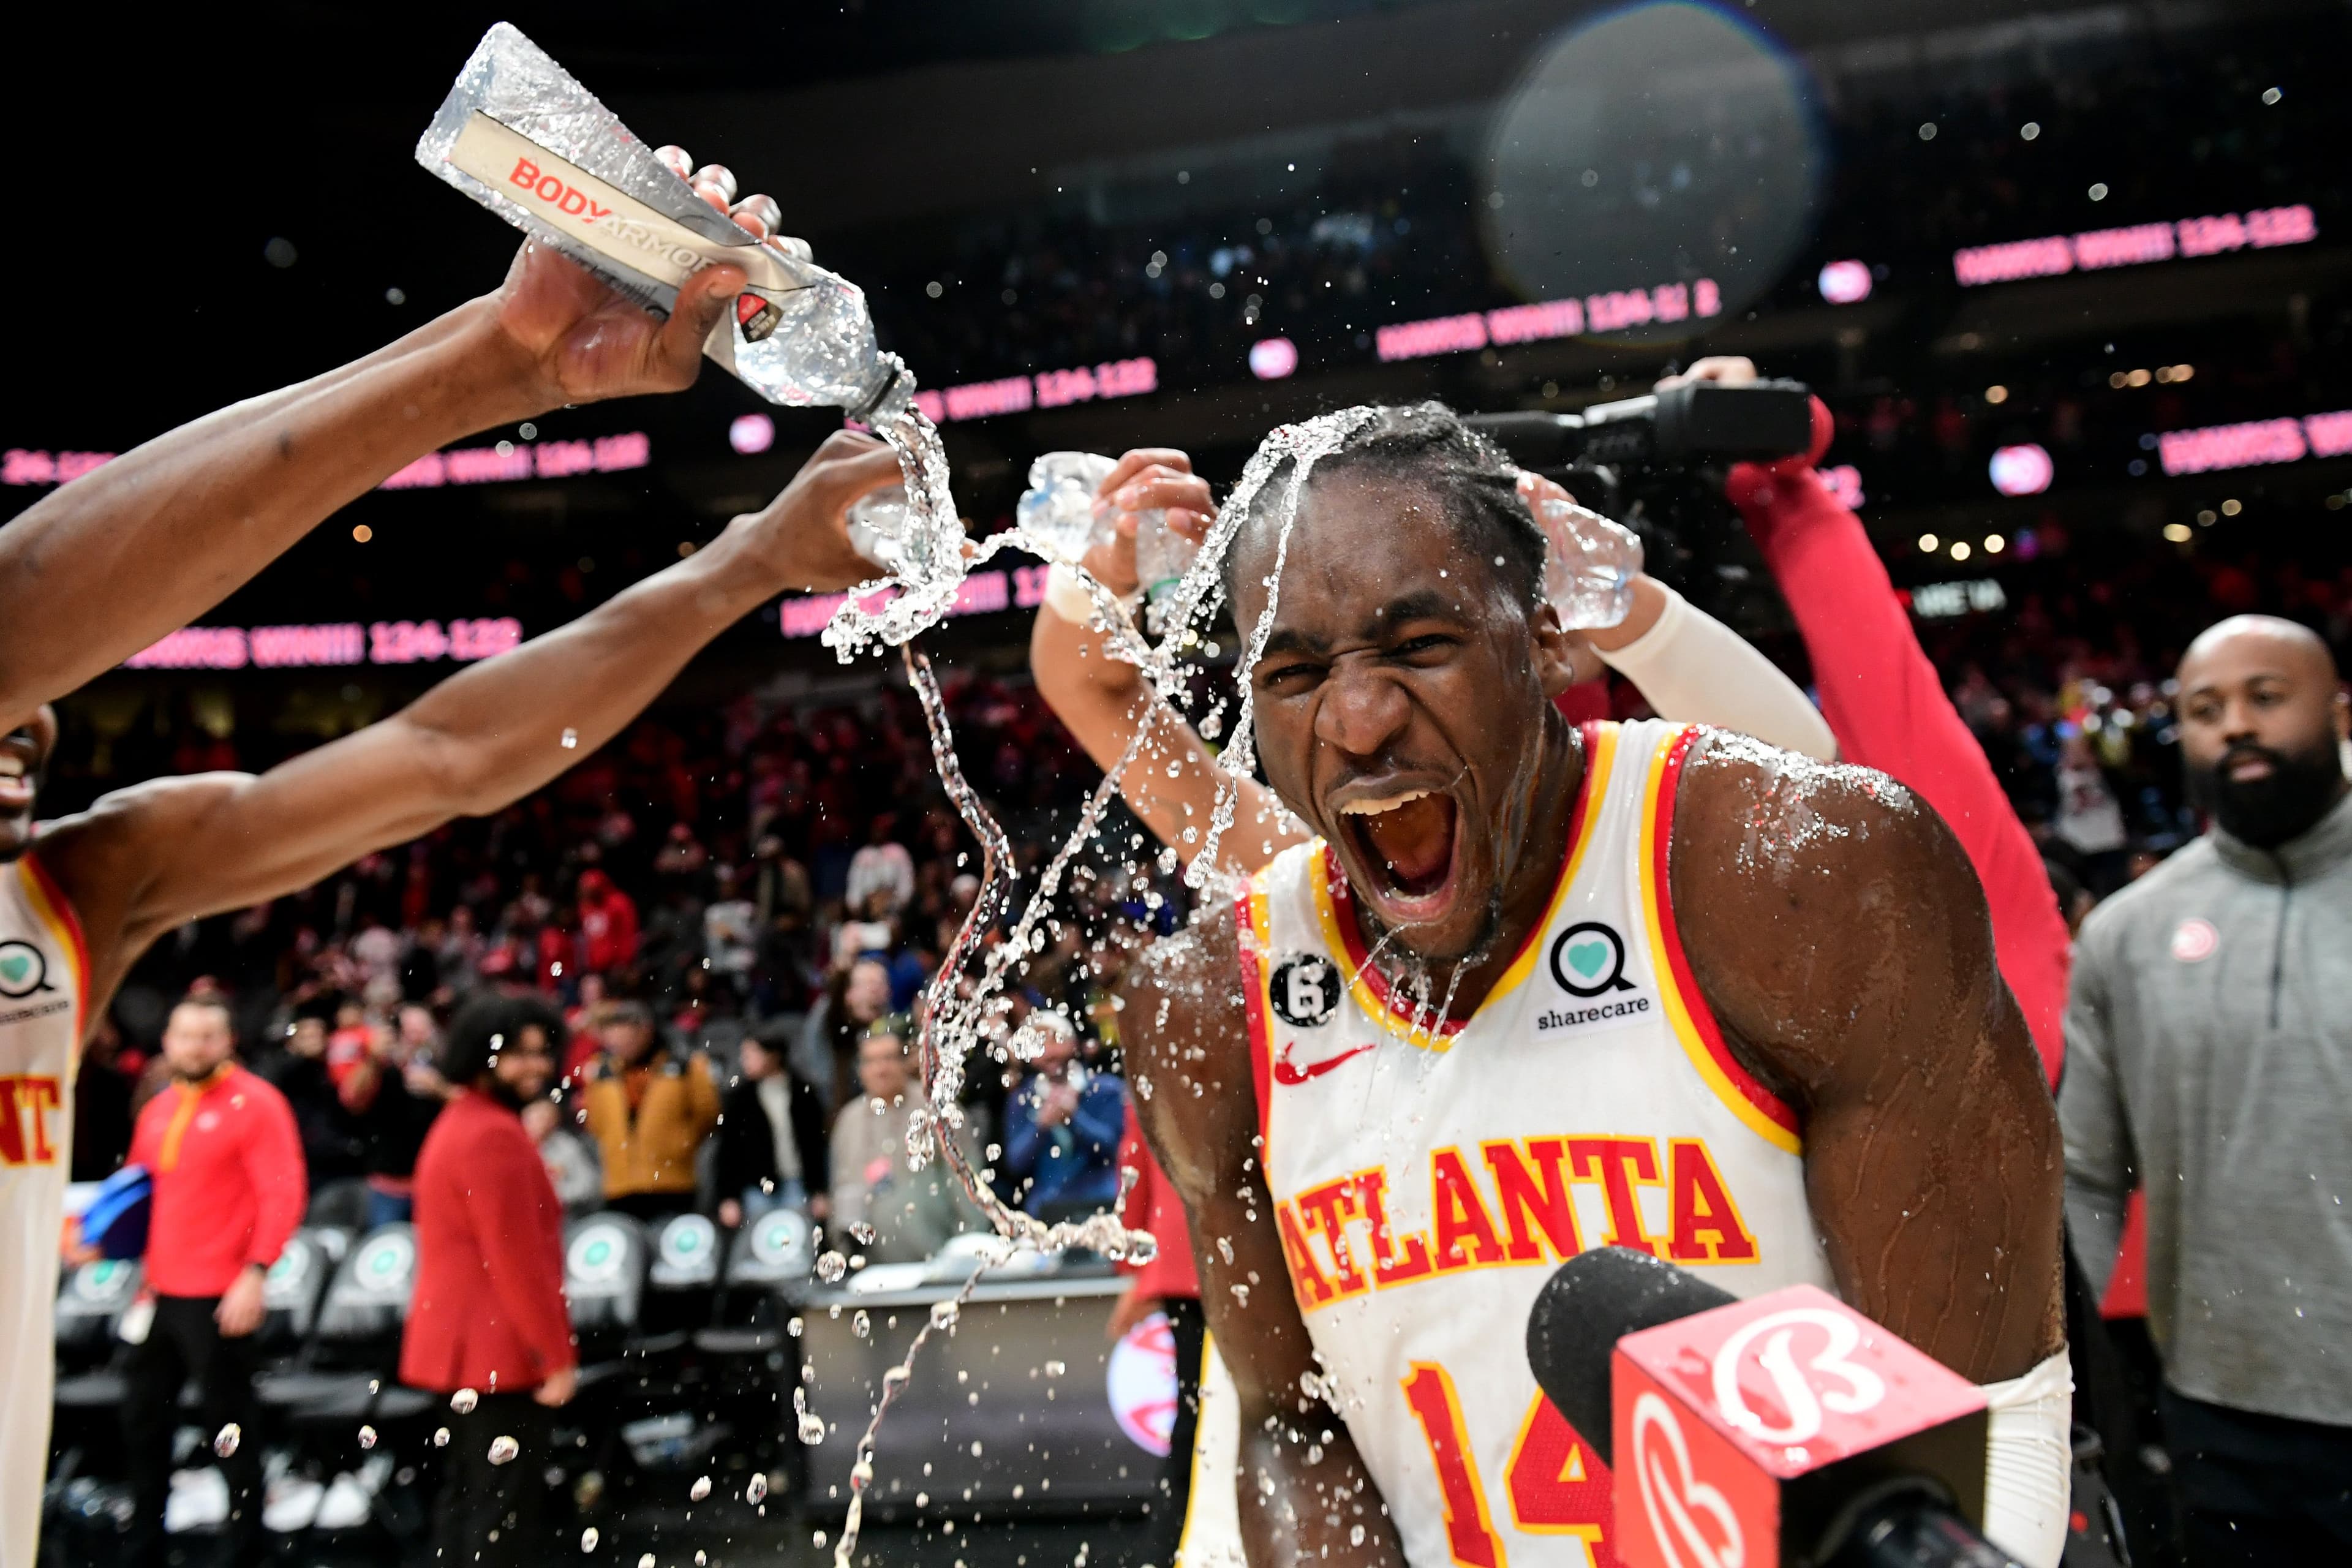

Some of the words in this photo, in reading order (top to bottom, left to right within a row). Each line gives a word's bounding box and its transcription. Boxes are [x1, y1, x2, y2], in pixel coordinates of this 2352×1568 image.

[1287, 962, 1325, 1019] 6
[1538, 998, 1649, 1030] sharecare
[1276, 1133, 1760, 1313] ATLANTA
